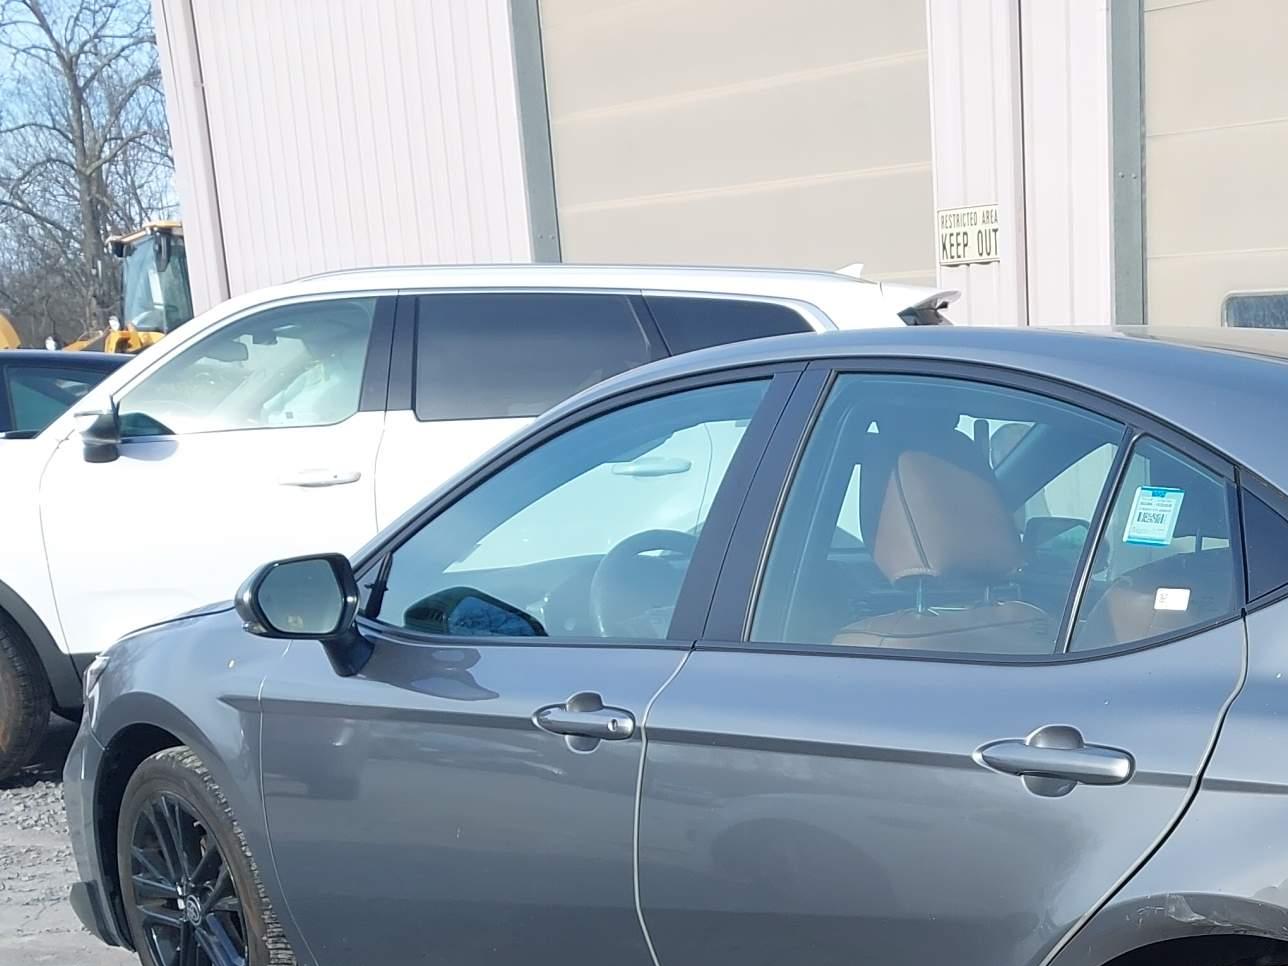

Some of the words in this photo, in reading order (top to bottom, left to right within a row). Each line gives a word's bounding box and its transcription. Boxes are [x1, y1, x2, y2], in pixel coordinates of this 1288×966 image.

[941, 212, 978, 229] RESTRICTED
[982, 209, 998, 225] AREA
[941, 231, 969, 260] KEEP
[977, 228, 999, 256] OUT
